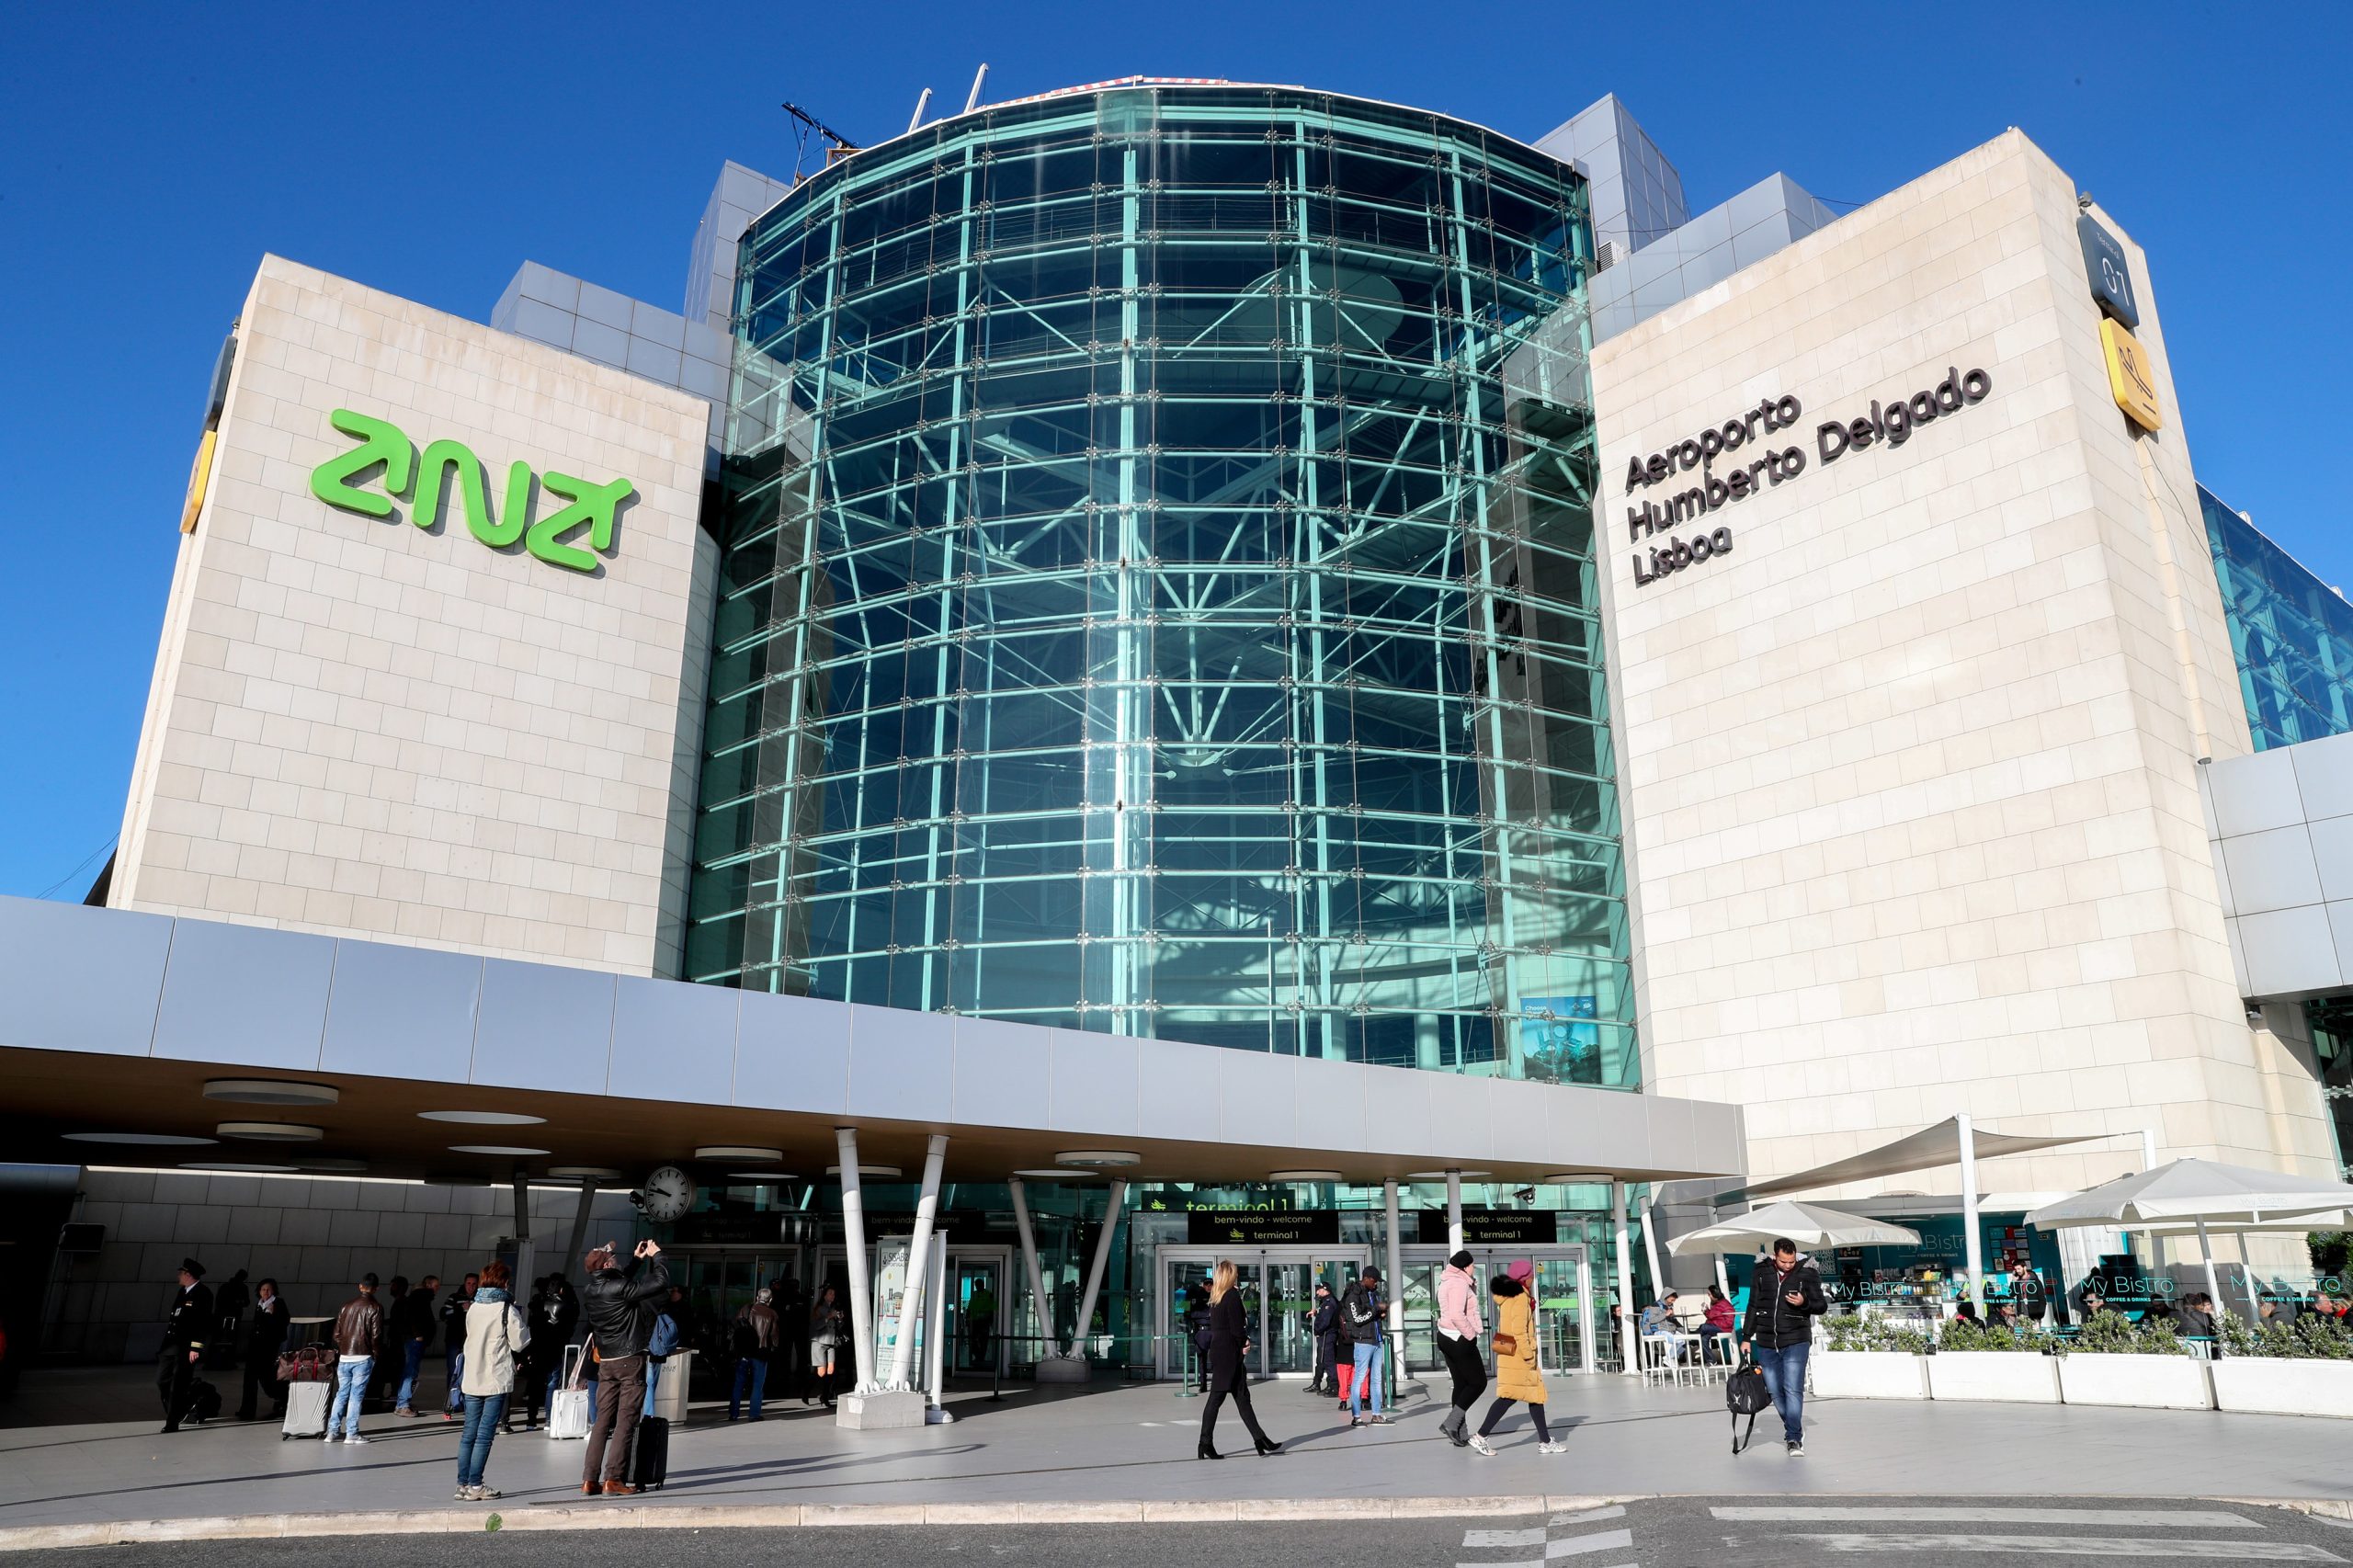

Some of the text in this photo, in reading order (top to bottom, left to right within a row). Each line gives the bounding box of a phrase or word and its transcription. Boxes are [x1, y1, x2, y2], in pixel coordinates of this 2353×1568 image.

[2102, 257, 2130, 307] 01
[1626, 395, 1802, 497] Aeroporto
[1627, 366, 1992, 544] Humberto Delgado
[1632, 527, 1733, 588] Lisboa
[1186, 1199, 1275, 1210] terminal
[1214, 1215, 1265, 1224] bem-vindo
[1272, 1215, 1313, 1223] welcome
[1443, 1215, 1489, 1223] b-vindo
[1496, 1215, 1533, 1223] welcome
[1254, 1230, 1293, 1239] terminal
[1480, 1230, 1516, 1239] terminal
[1925, 1234, 1965, 1250] Bistr
[2080, 1276, 2174, 1297] My Bistro
